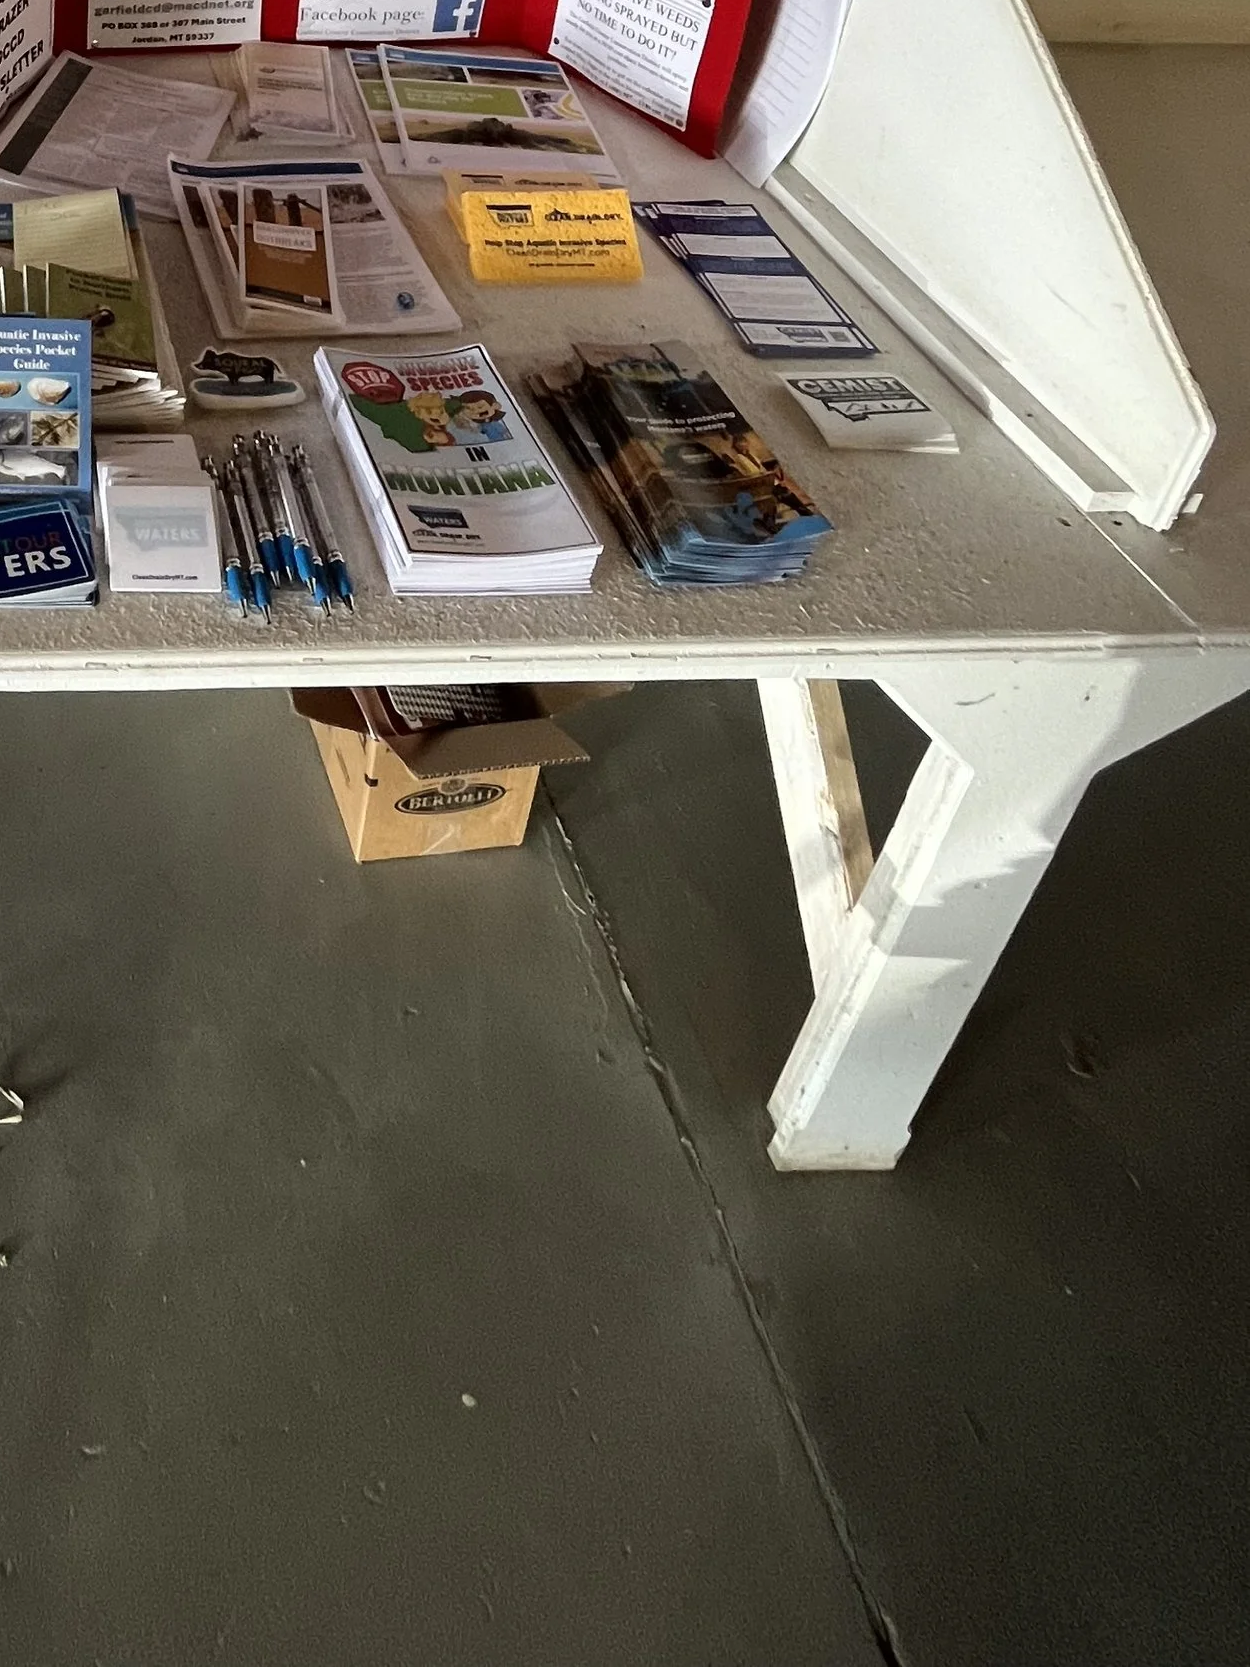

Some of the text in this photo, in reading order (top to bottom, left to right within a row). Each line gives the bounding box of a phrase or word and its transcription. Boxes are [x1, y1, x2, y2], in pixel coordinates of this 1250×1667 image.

[32, 329, 81, 341] Invasive
[35, 345, 76, 356] Pocket
[13, 360, 50, 370] Guide
[348, 367, 390, 385] STOP
[406, 371, 483, 391] SPECIES
[798, 378, 902, 394] CEMIST
[466, 446, 490, 462] IN
[379, 460, 556, 496] MONTANA
[408, 789, 492, 810] BERTOLLI
